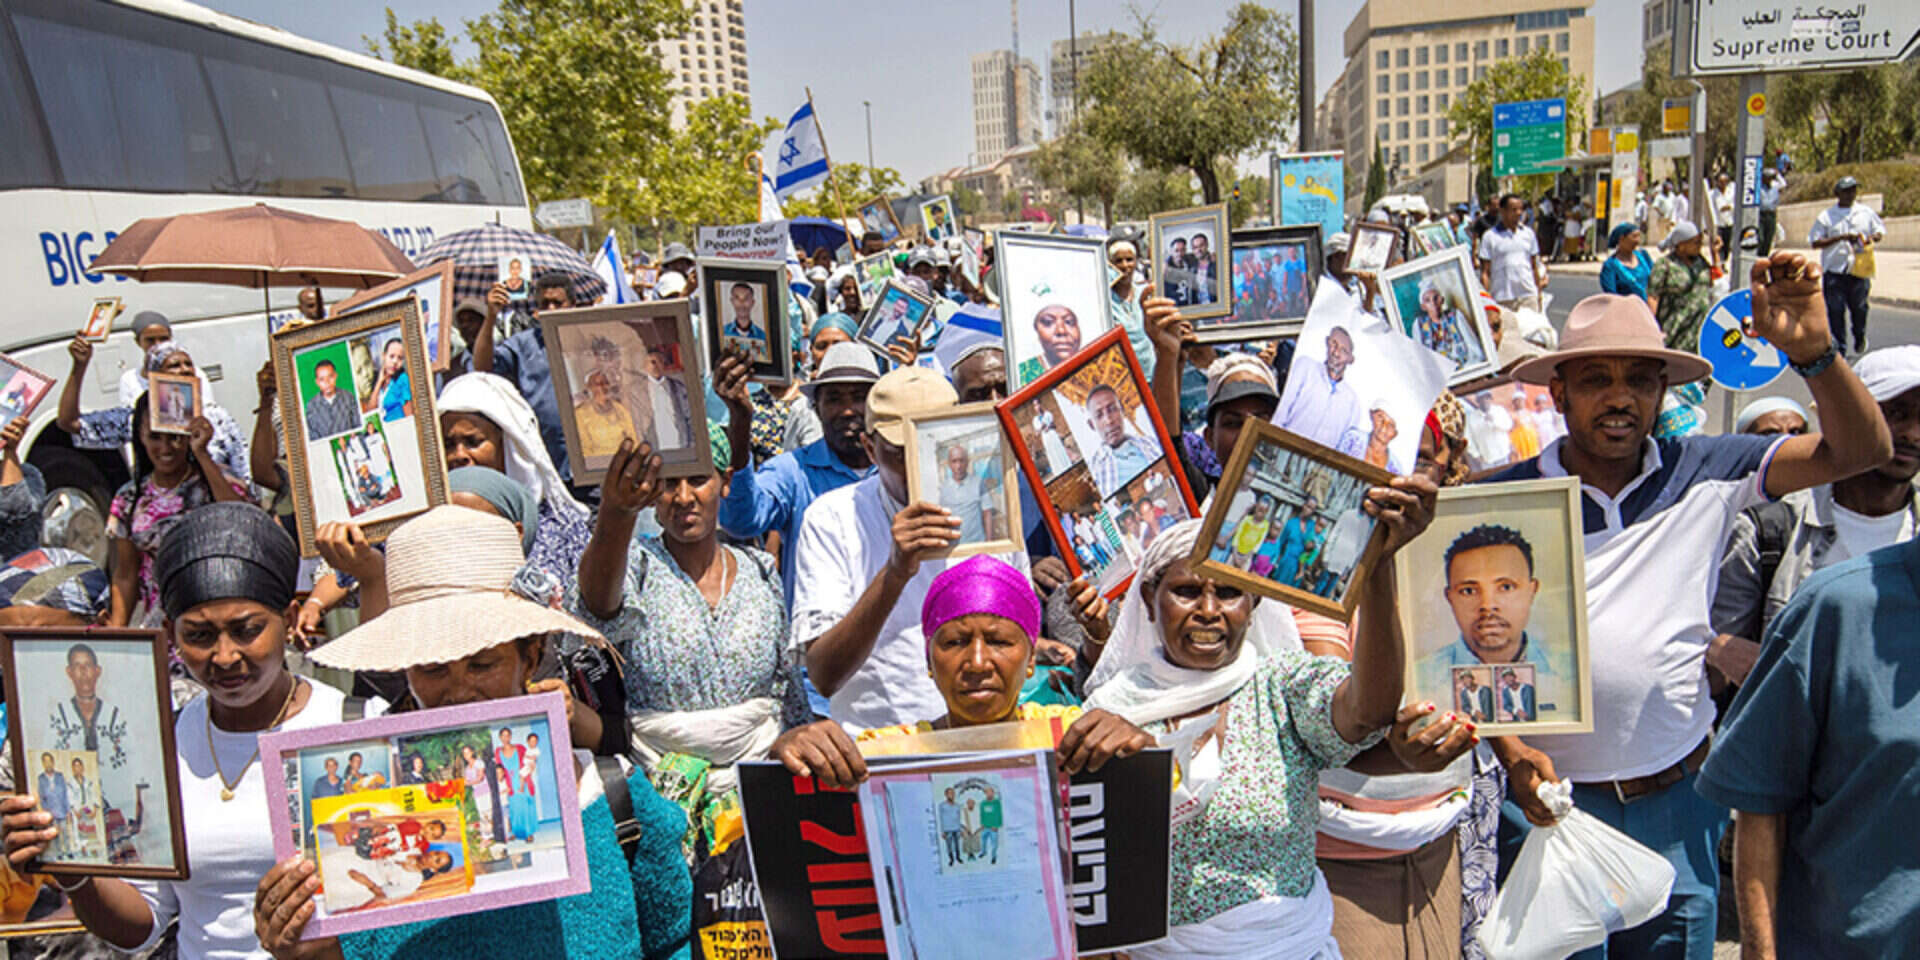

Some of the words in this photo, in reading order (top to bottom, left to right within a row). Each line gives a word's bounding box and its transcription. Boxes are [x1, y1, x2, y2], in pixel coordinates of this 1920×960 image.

[1712, 37, 1815, 61] Supreme
[1825, 29, 1891, 50] Court
[704, 237, 749, 251] People
[716, 227, 751, 239] Bring
[39, 231, 104, 287] BIG
